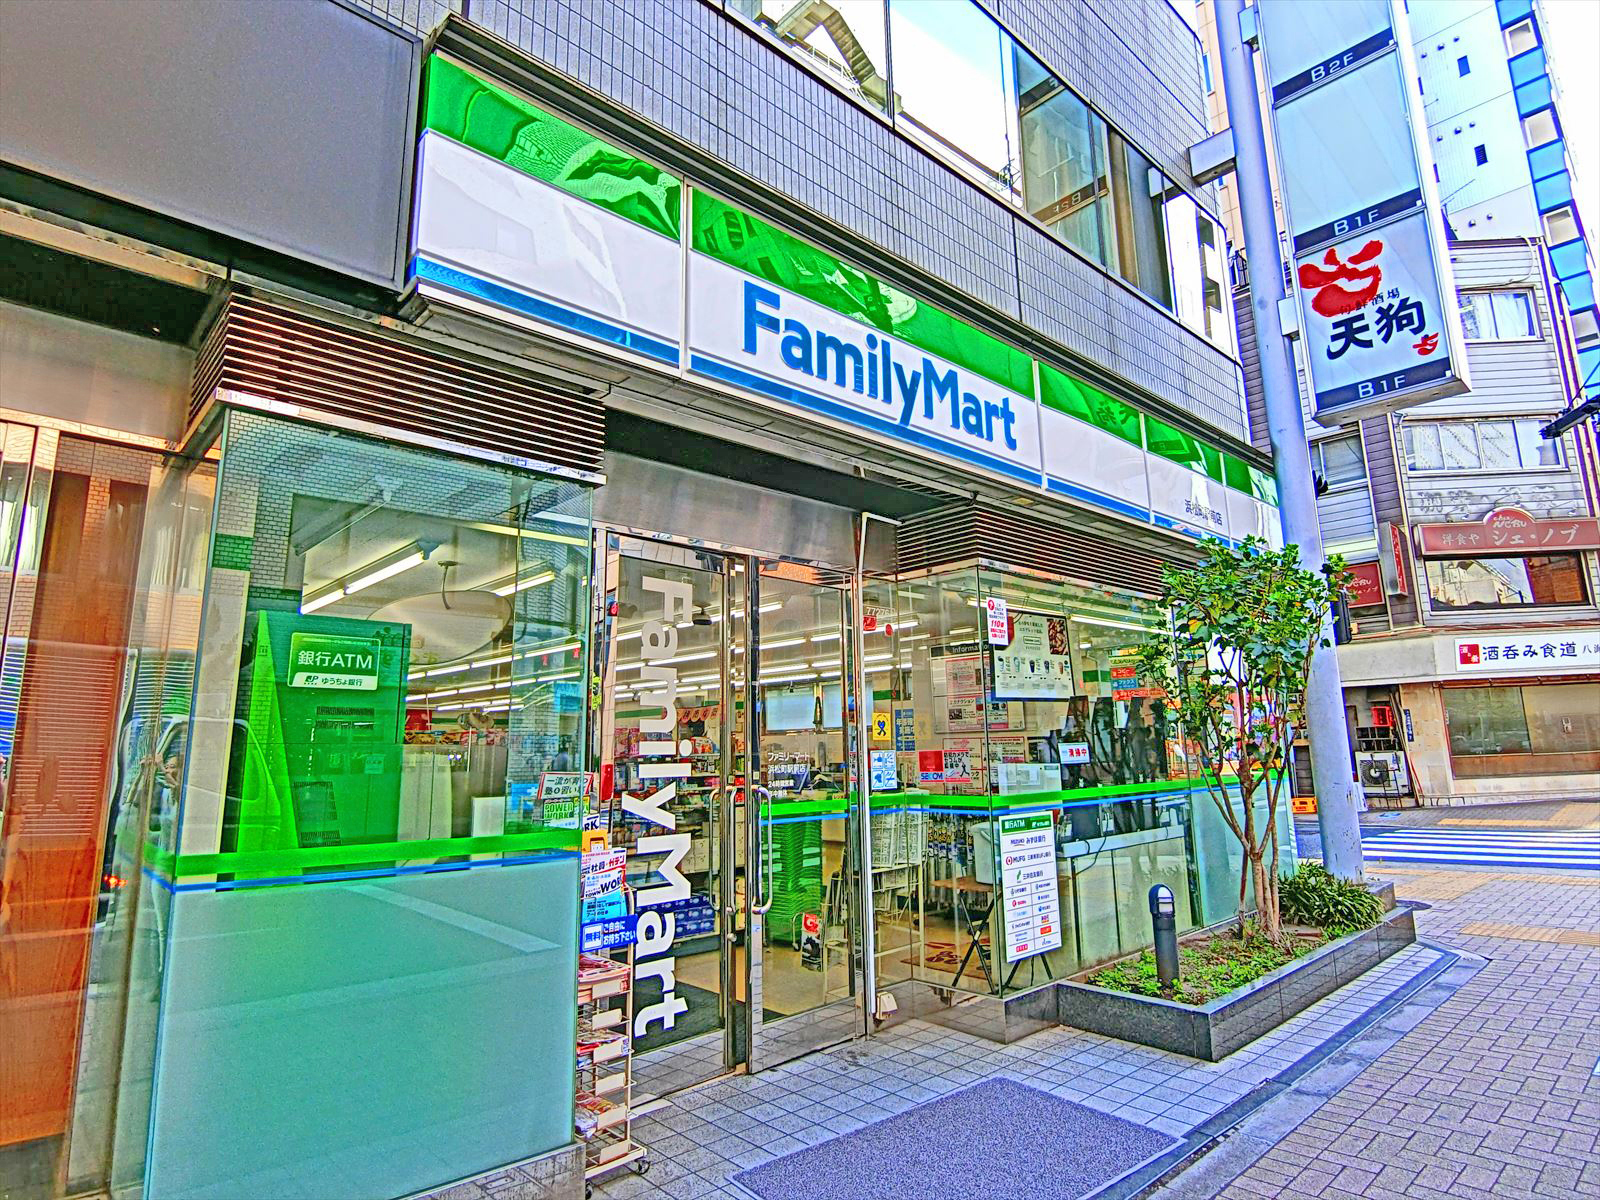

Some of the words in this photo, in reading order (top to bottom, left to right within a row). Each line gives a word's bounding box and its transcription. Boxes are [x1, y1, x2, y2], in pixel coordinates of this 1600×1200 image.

[1310, 52, 1355, 83] B2F
[1333, 209, 1380, 236] B1F
[1326, 296, 1426, 361] 天狗
[741, 279, 1018, 451] FamilyMart
[1357, 374, 1407, 399] B1F
[1442, 533, 1480, 545] 洋食や
[1492, 524, 1580, 546] シェ・ノブ
[297, 650, 373, 669] 銀行ATM
[1482, 641, 1578, 661] 酒呑み食道
[321, 677, 363, 687] ゆうちょ銀行
[621, 575, 694, 1038] FamilyMart
